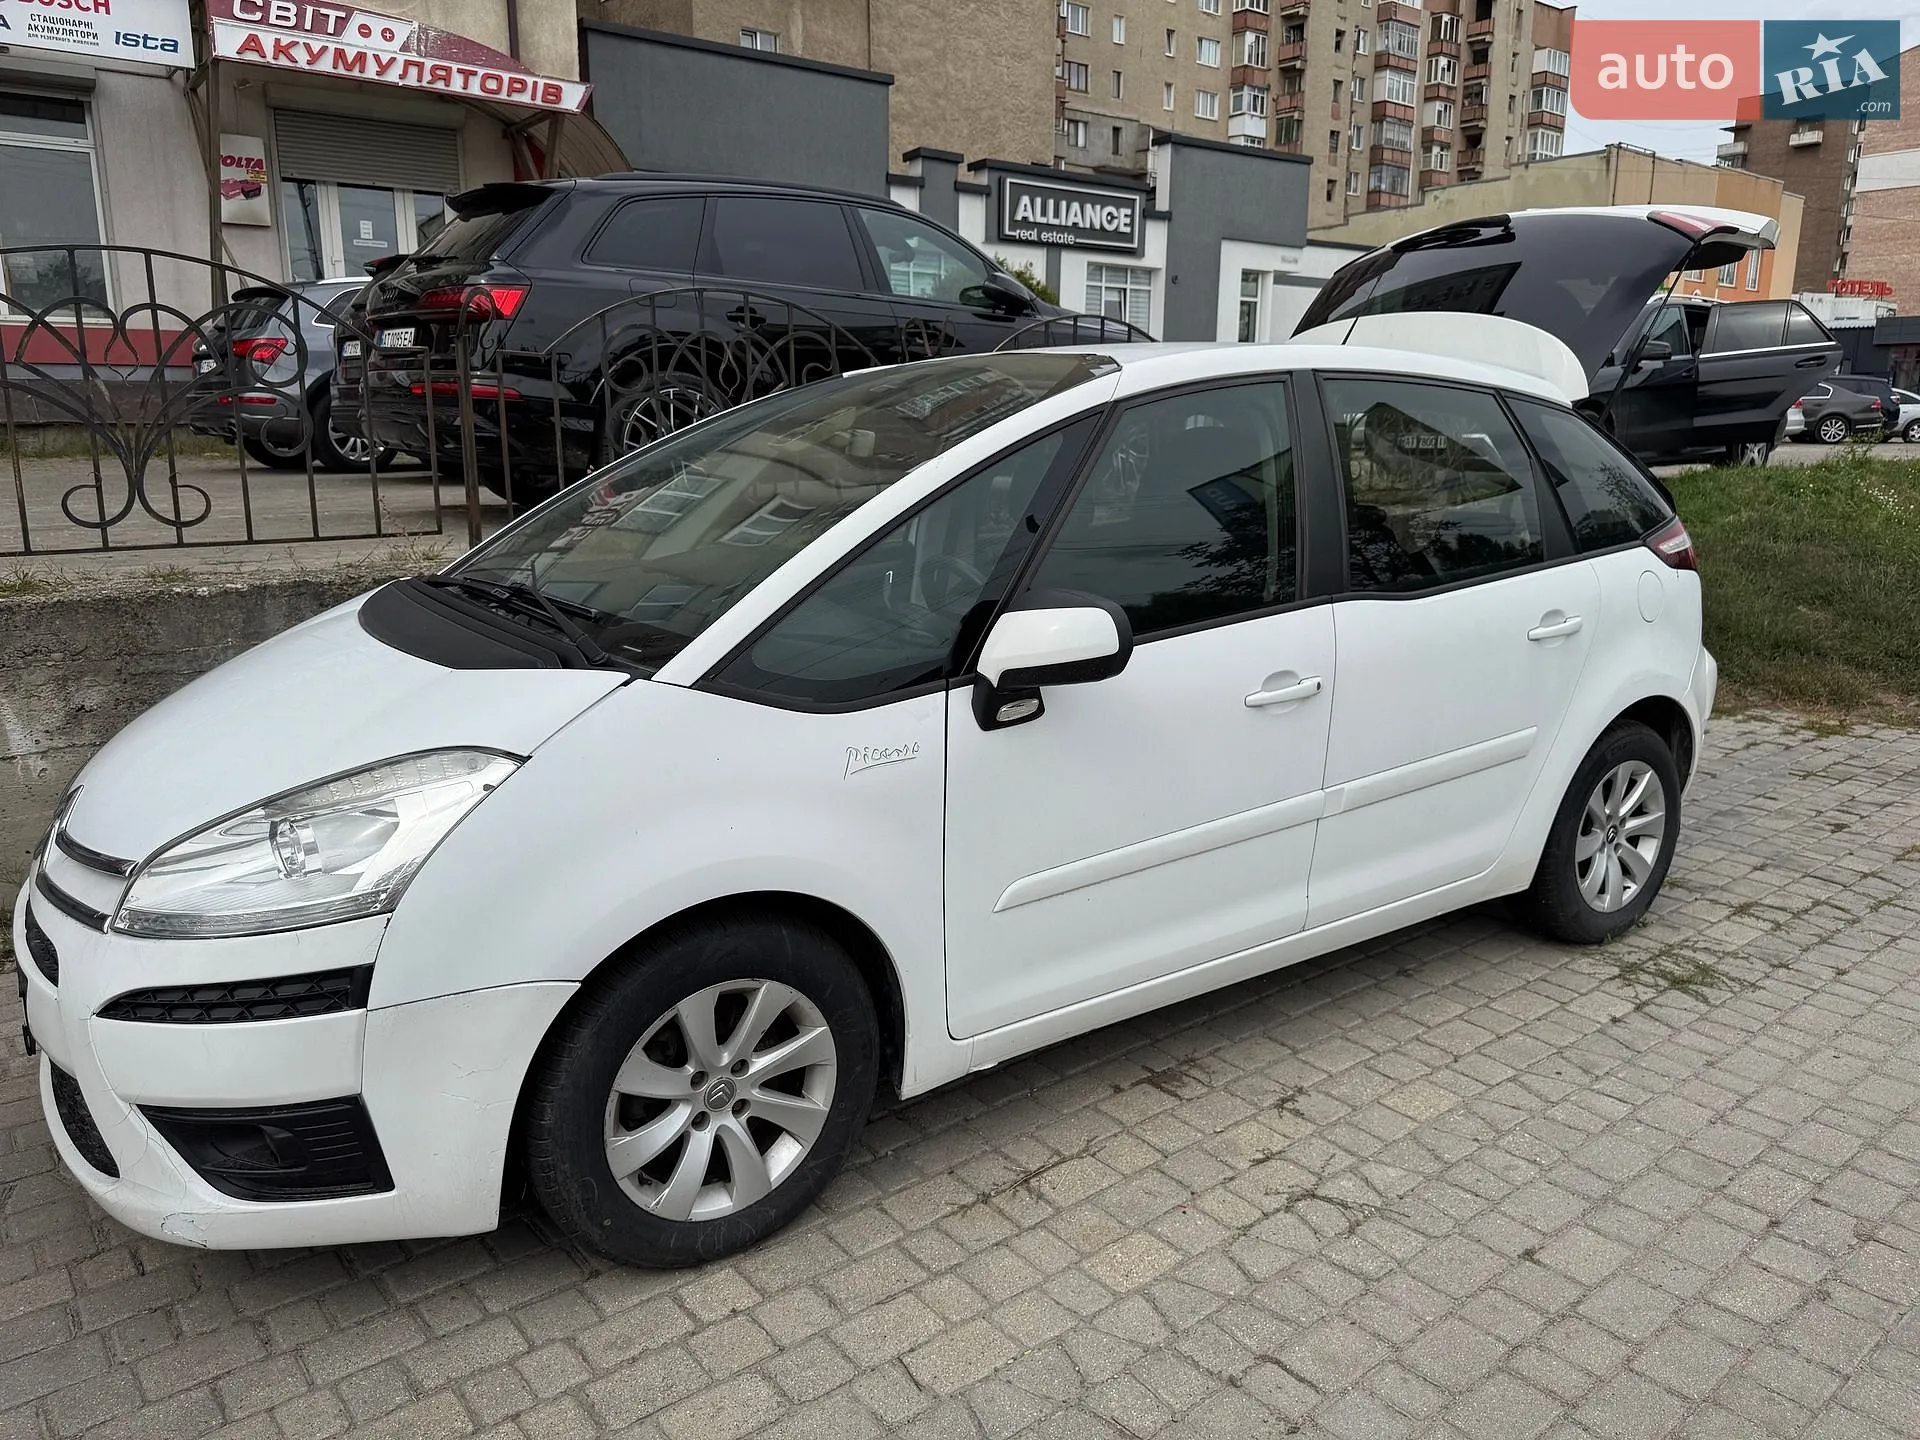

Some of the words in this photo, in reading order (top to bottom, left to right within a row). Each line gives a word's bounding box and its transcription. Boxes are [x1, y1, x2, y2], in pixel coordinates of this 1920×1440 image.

[30, 13, 94, 30] СТАЦІОНАРНІ
[232, 0, 347, 35] СВІТ
[27, 23, 99, 41] АКУМУЛЯТОРИ
[236, 33, 563, 105] АКУМУЛЯТОРІВ
[220, 154, 265, 170] OLTA
[1013, 195, 1132, 234] ALLIANCE
[1015, 228, 1038, 241] real
[1040, 231, 1075, 245] estate
[1827, 279, 1895, 297] ГОТЕЛЬ
